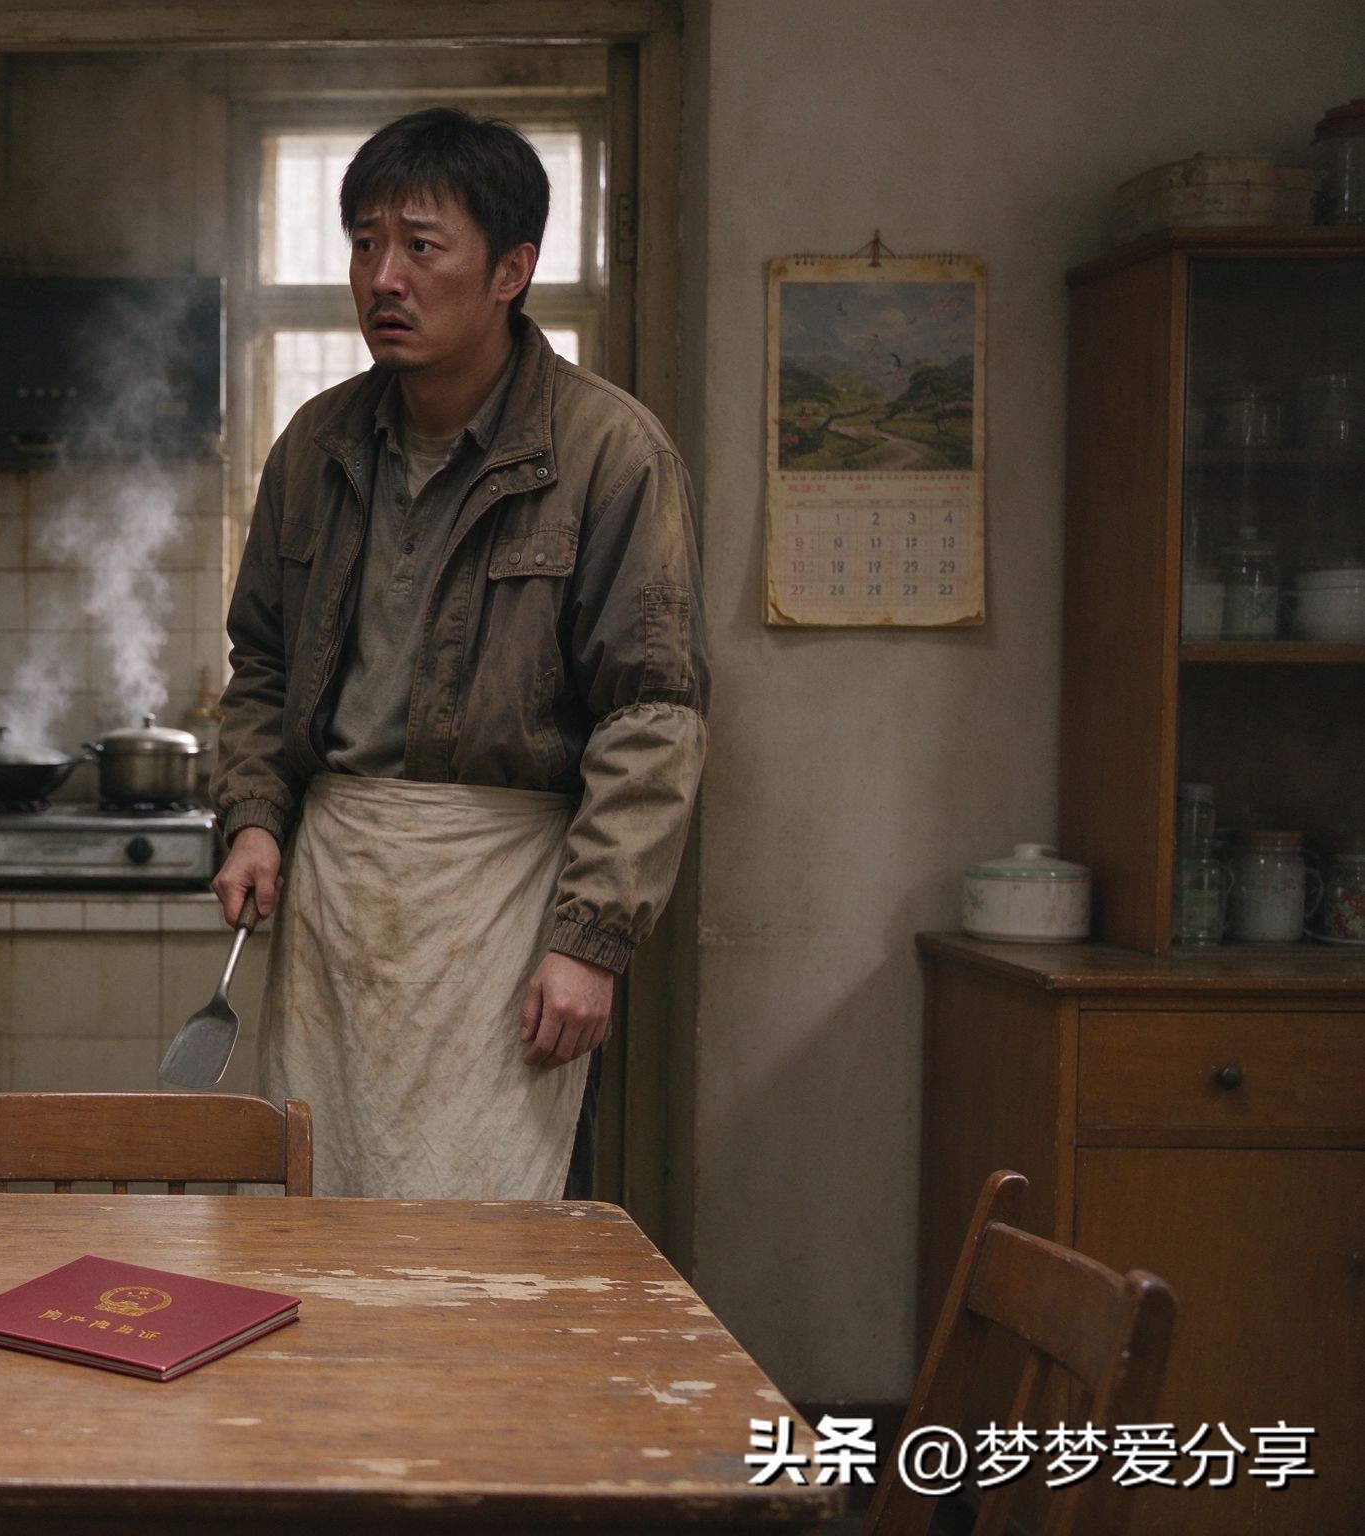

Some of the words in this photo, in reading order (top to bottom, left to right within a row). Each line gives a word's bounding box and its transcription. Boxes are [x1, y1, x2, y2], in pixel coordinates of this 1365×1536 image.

[871, 511, 881, 526] 2
[906, 511, 917, 526] 3
[943, 511, 954, 525] 4
